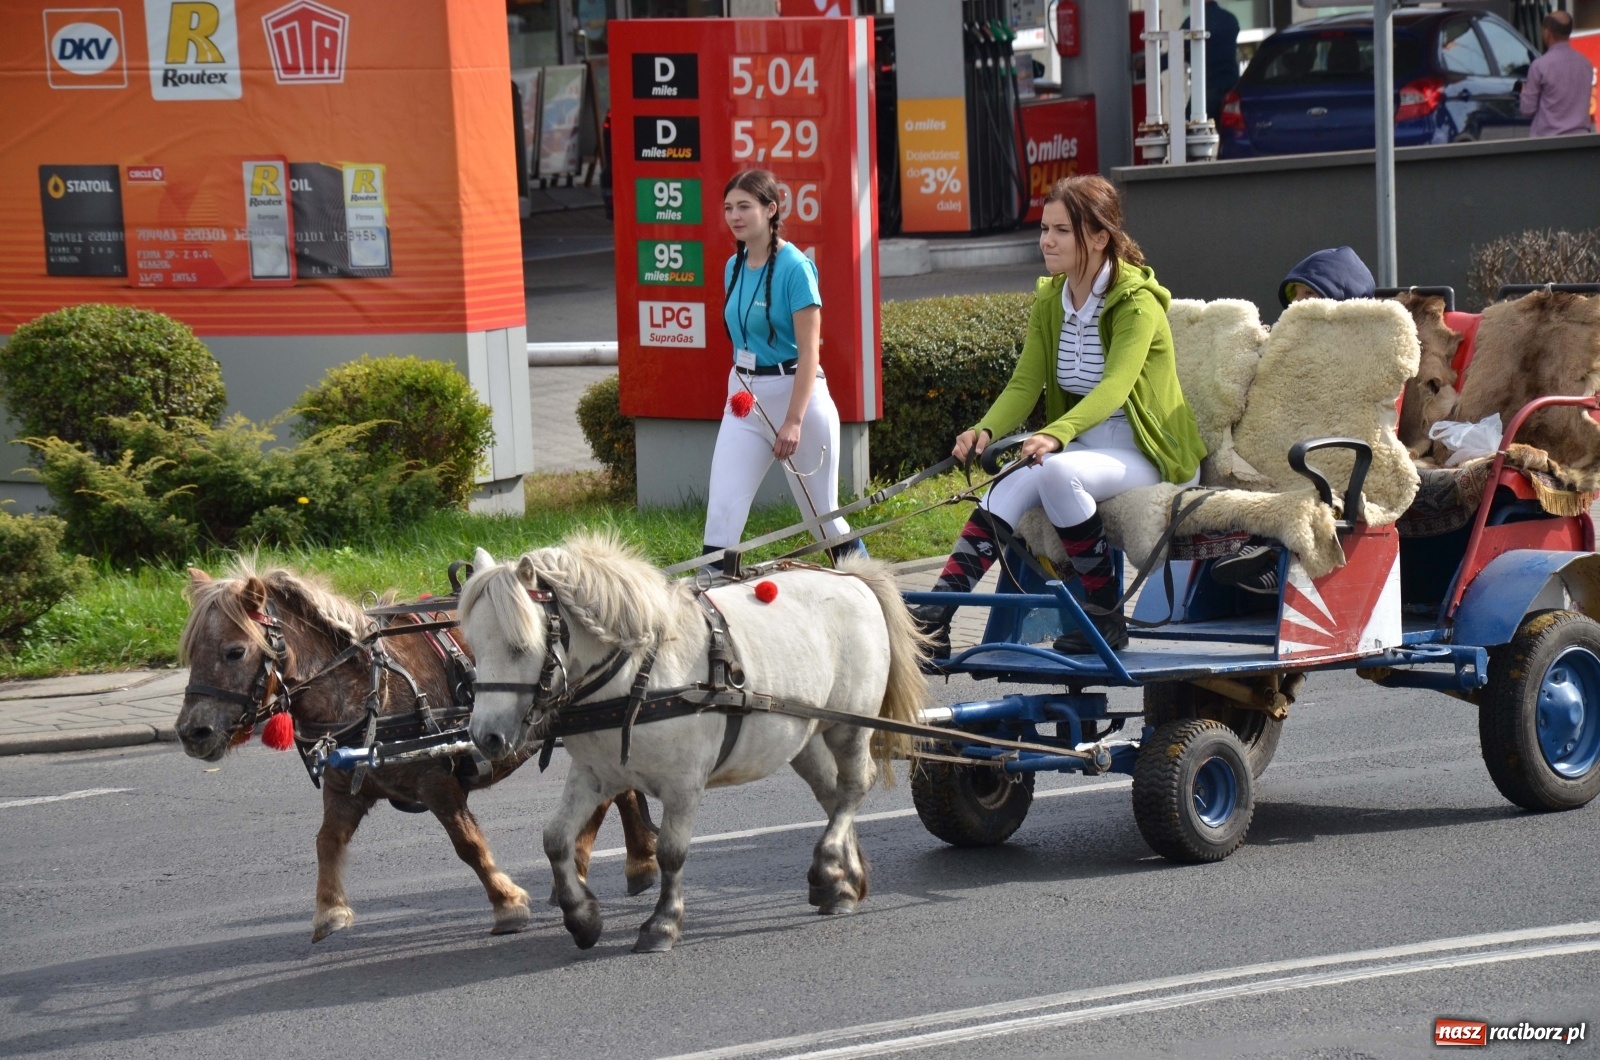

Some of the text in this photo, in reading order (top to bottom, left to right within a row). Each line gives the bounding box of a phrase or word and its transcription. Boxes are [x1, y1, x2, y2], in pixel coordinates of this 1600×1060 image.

[58, 38, 112, 60] DKV
[269, 6, 340, 76] UTA
[162, 69, 227, 87] Routex
[655, 57, 675, 82] D
[732, 57, 819, 99] 5,04
[652, 85, 678, 96] miles
[656, 119, 677, 145] D
[915, 119, 947, 131] miles
[734, 120, 818, 162] 5,29
[1037, 134, 1078, 162] miles
[906, 150, 960, 162] Dojedziesz
[129, 170, 152, 178] CIRCLE
[907, 167, 961, 195] do 3%
[67, 180, 113, 193] STATOIL
[653, 182, 683, 208] 95
[249, 198, 282, 207] Routex
[351, 194, 378, 202] Routex
[937, 200, 961, 213] dalej
[656, 210, 682, 221] miles
[654, 243, 683, 269] 95
[649, 306, 692, 329] LPG
[649, 333, 694, 344] SupraGas
